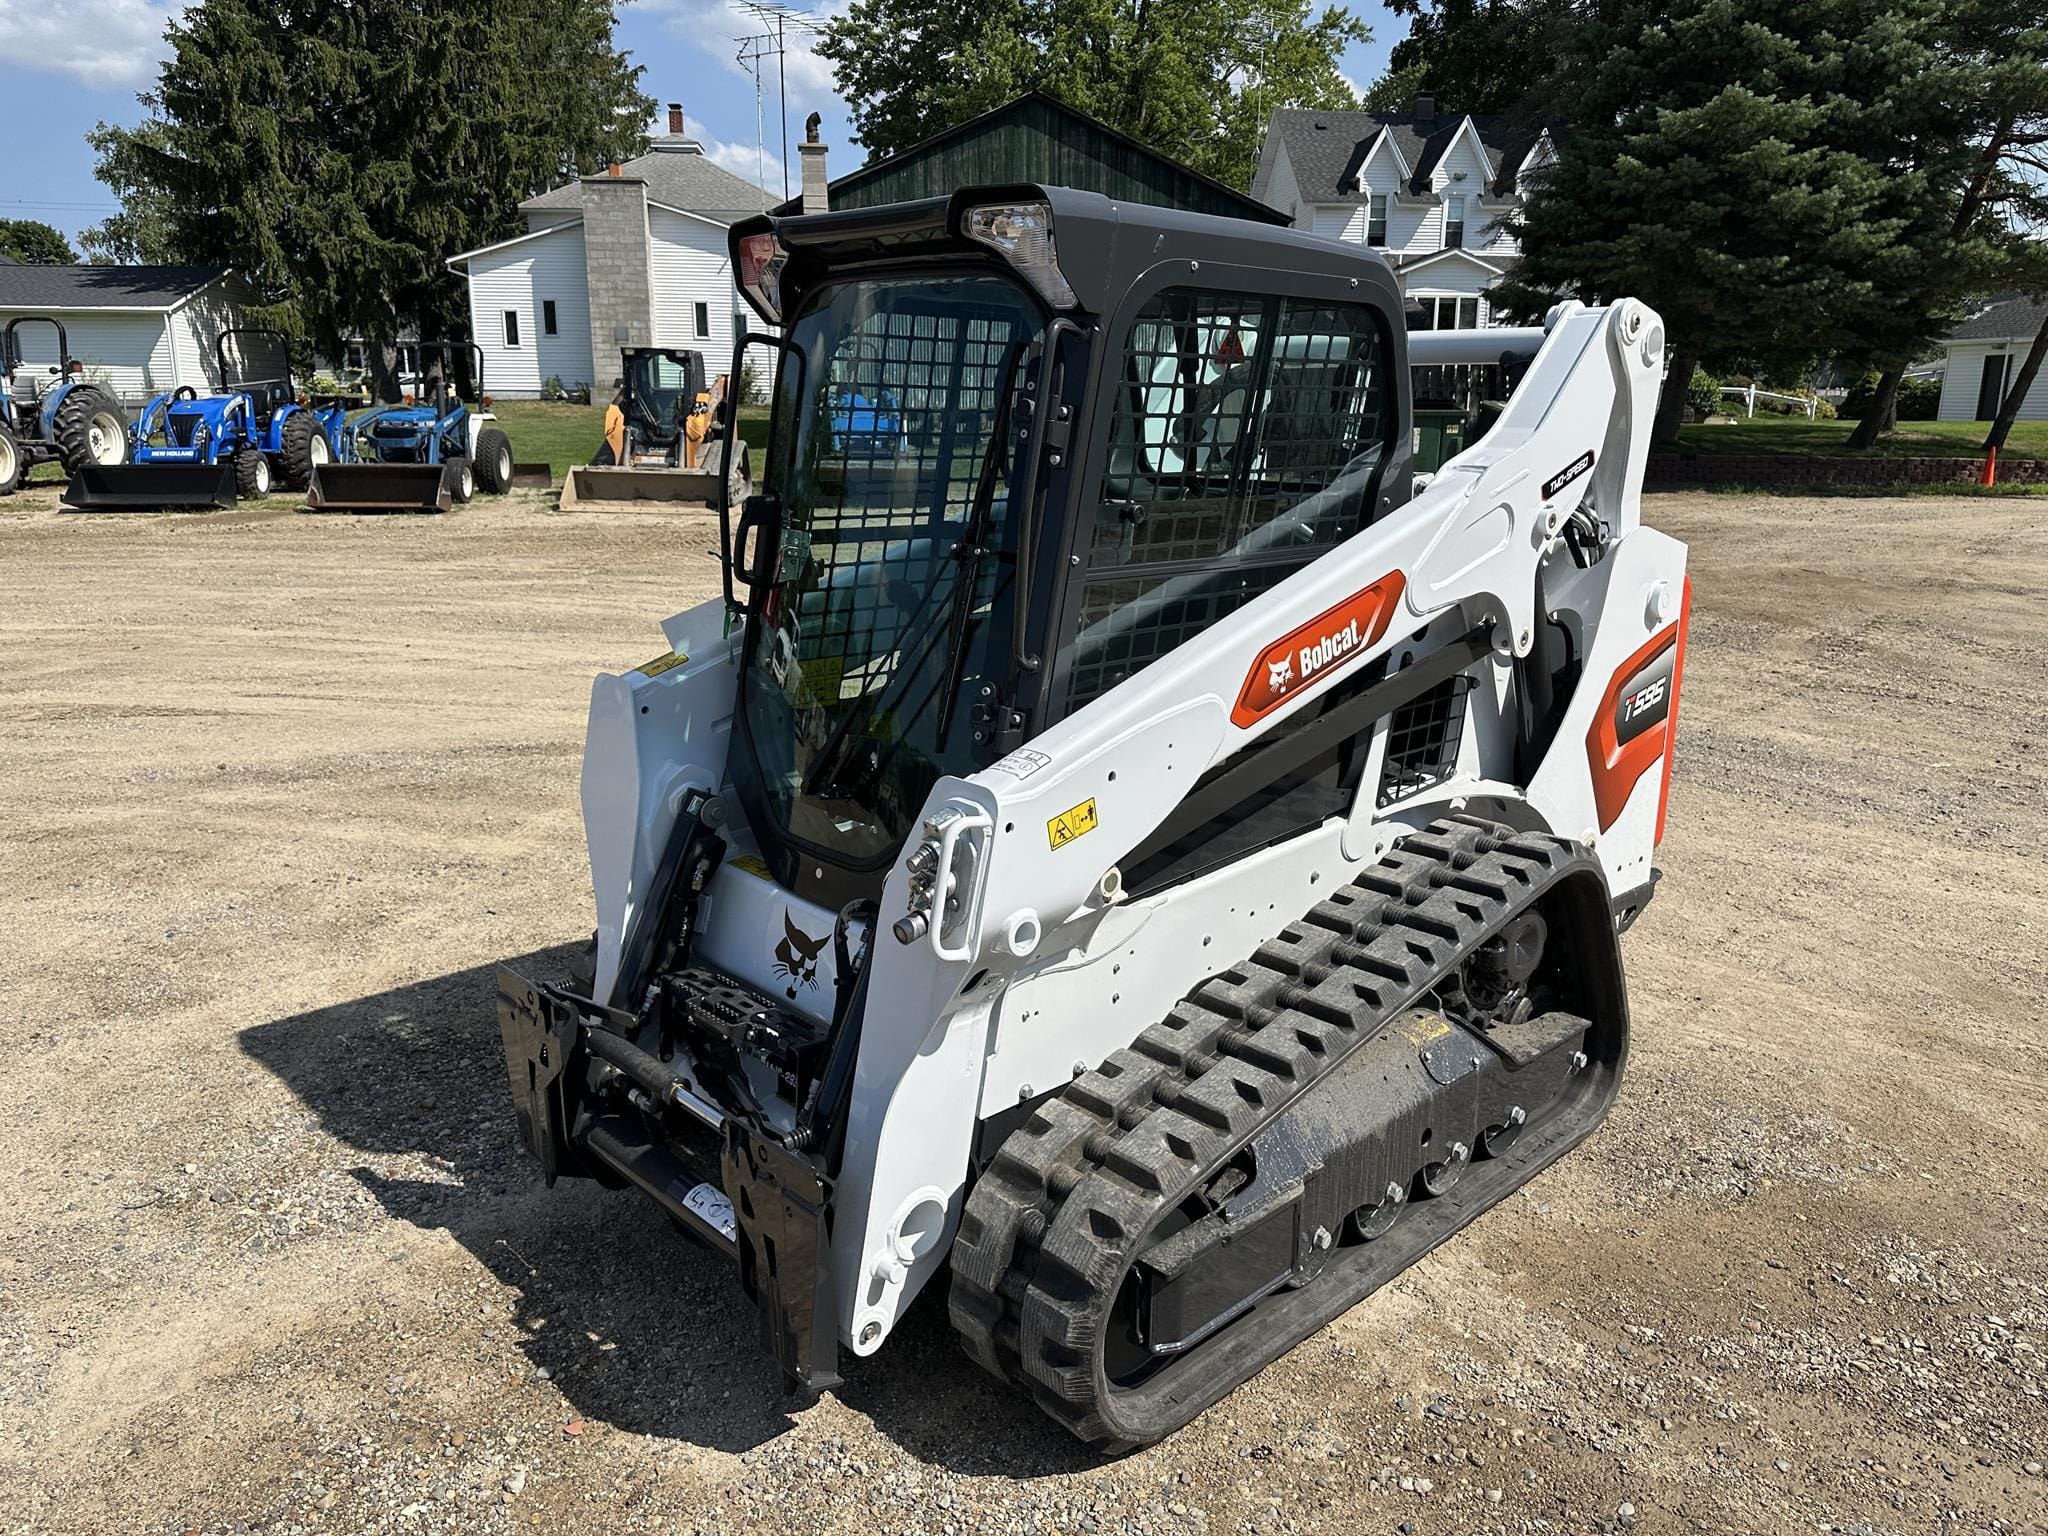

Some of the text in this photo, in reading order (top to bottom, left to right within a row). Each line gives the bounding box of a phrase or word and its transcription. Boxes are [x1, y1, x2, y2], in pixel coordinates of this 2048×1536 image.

[1550, 455, 1589, 493] TWO-SPEED
[1299, 617, 1359, 679] Bobcat
[1625, 676, 1667, 722] T595
